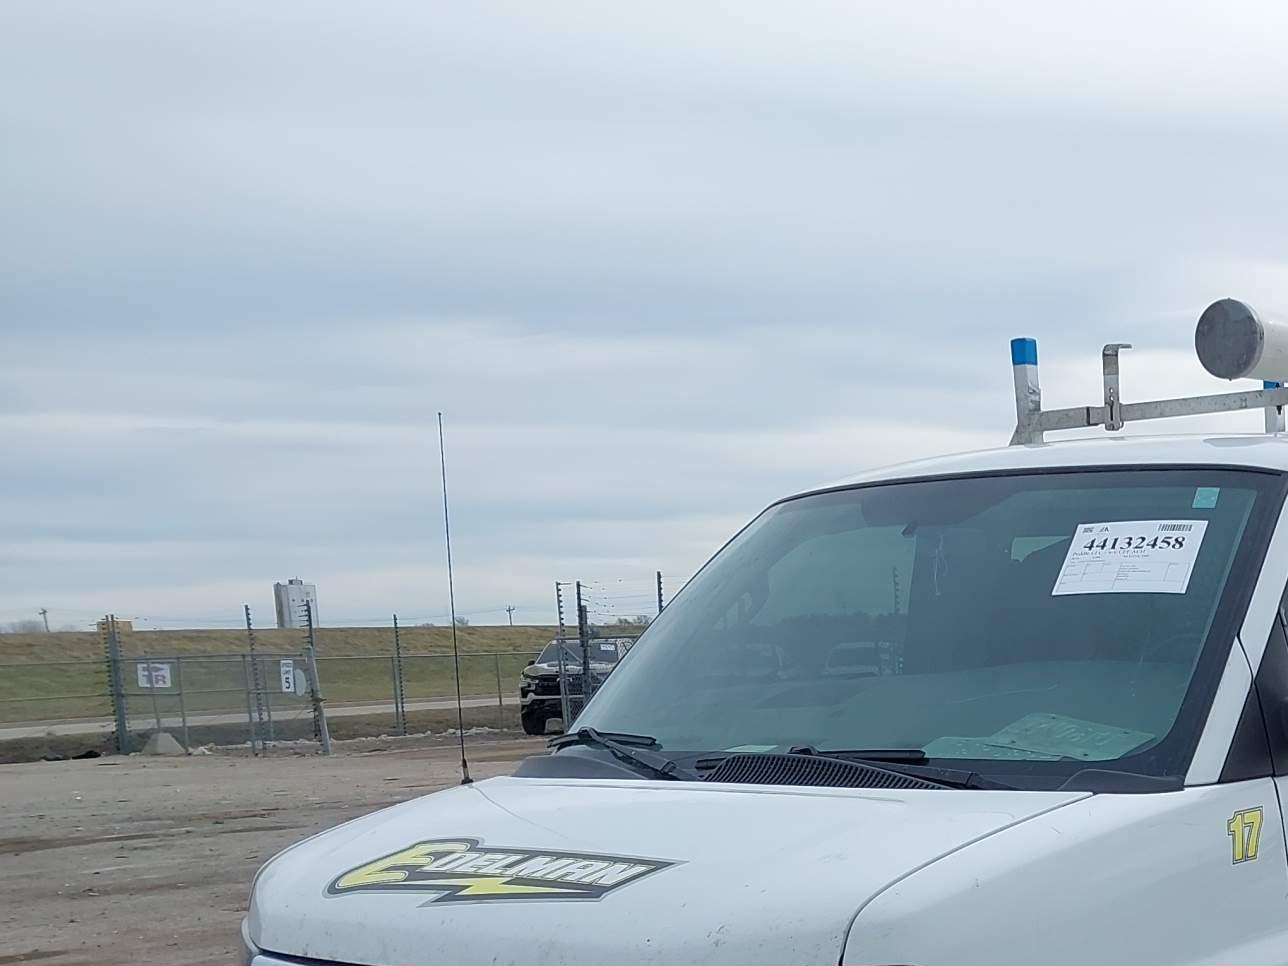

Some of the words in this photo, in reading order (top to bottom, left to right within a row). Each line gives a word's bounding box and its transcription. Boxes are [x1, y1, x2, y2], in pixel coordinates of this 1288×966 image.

[1083, 536, 1186, 551] 44132458
[1227, 806, 1263, 864] 17
[335, 841, 656, 887] EDELMAN
